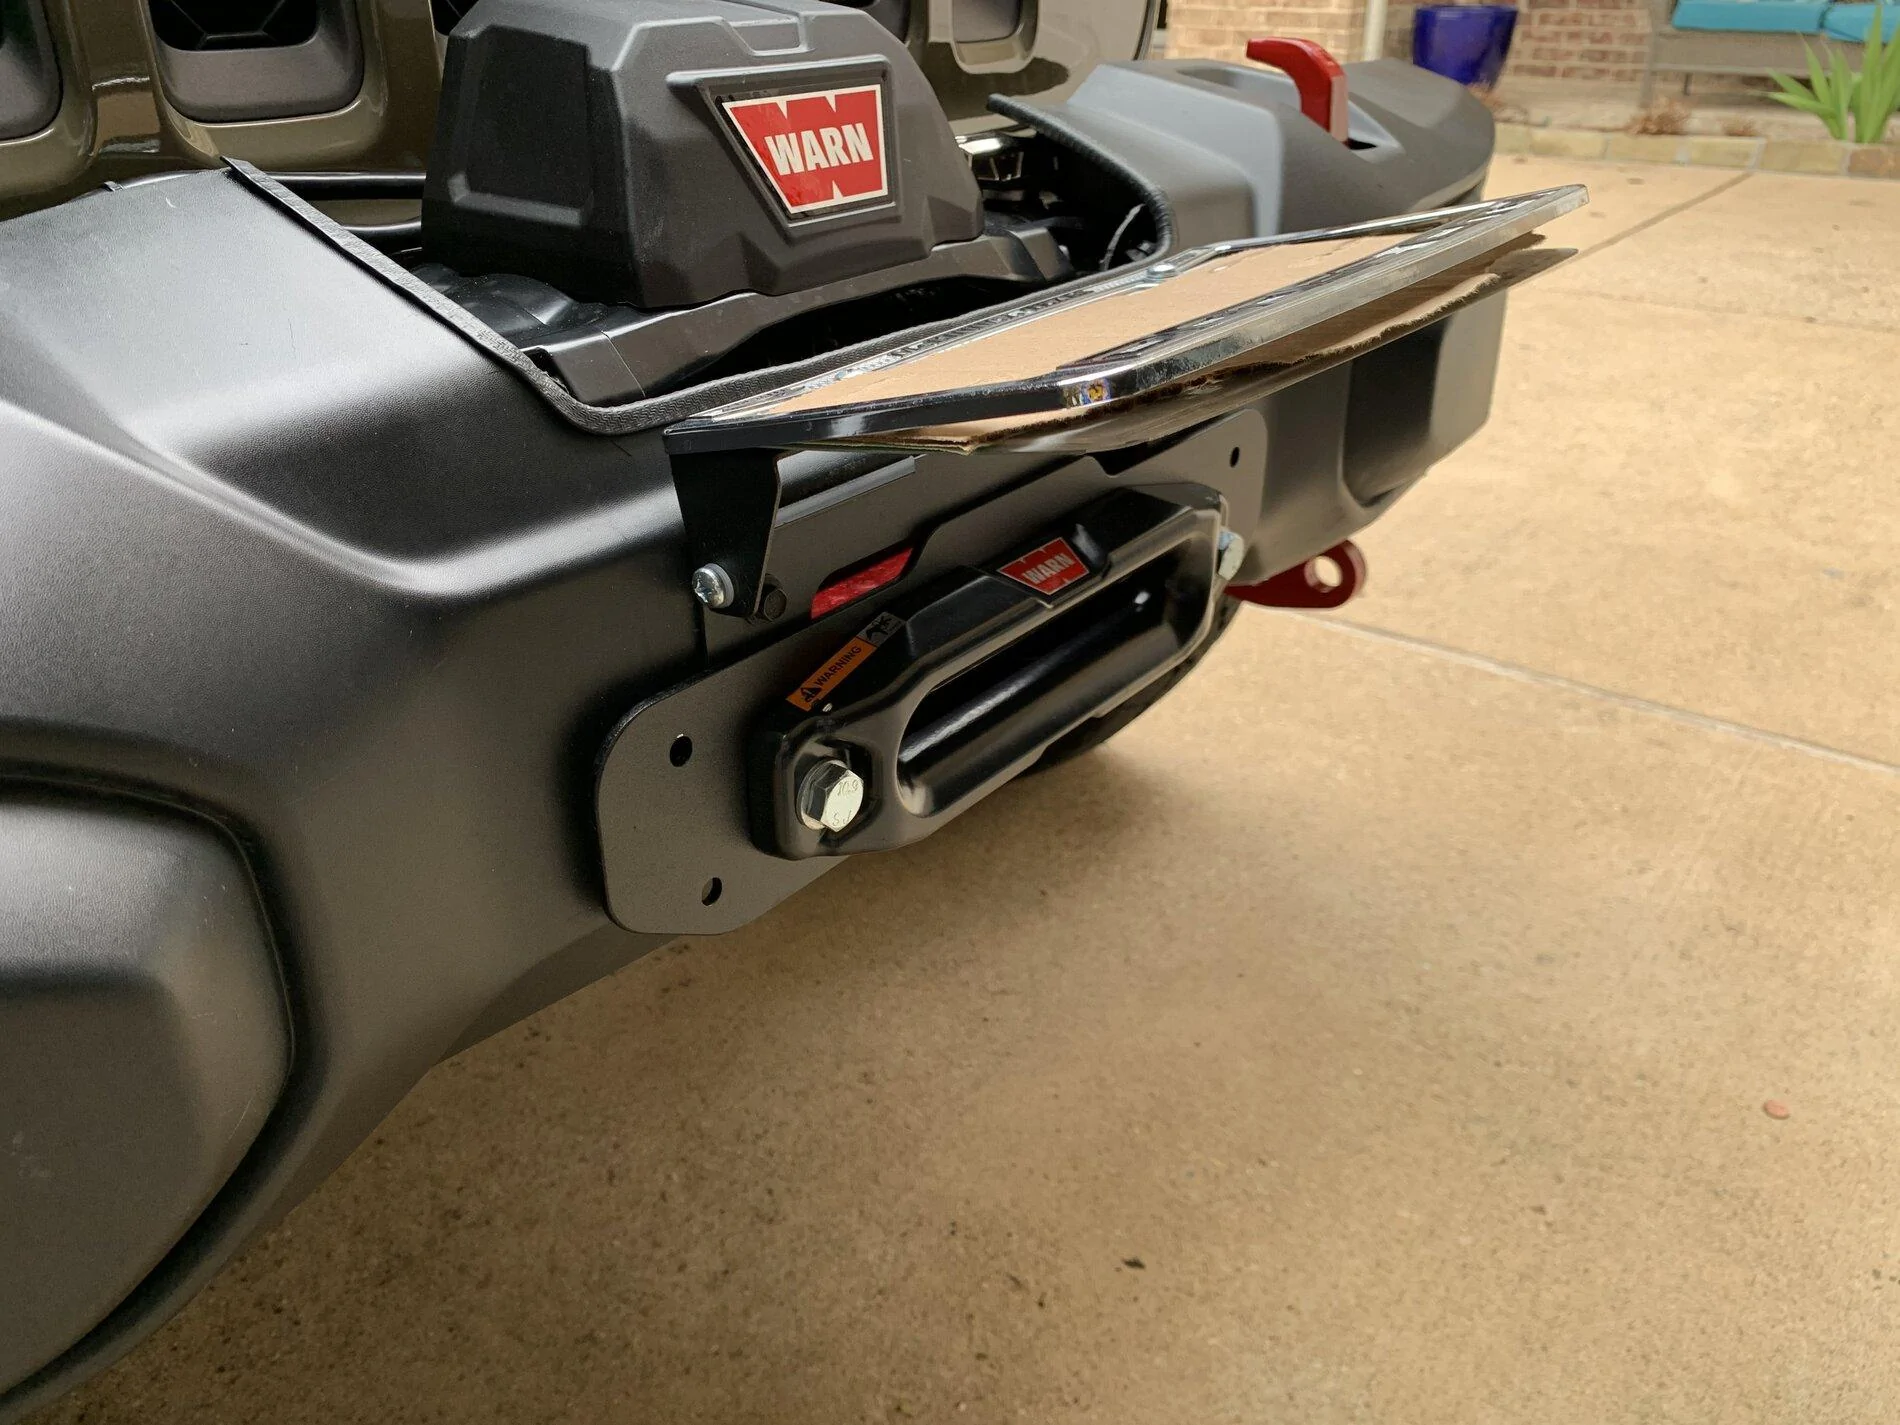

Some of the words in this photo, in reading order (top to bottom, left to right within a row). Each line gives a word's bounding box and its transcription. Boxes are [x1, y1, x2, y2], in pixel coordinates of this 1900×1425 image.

[764, 122, 874, 176] WARN
[1021, 552, 1076, 585] WARN
[814, 645, 862, 687] WARNING
